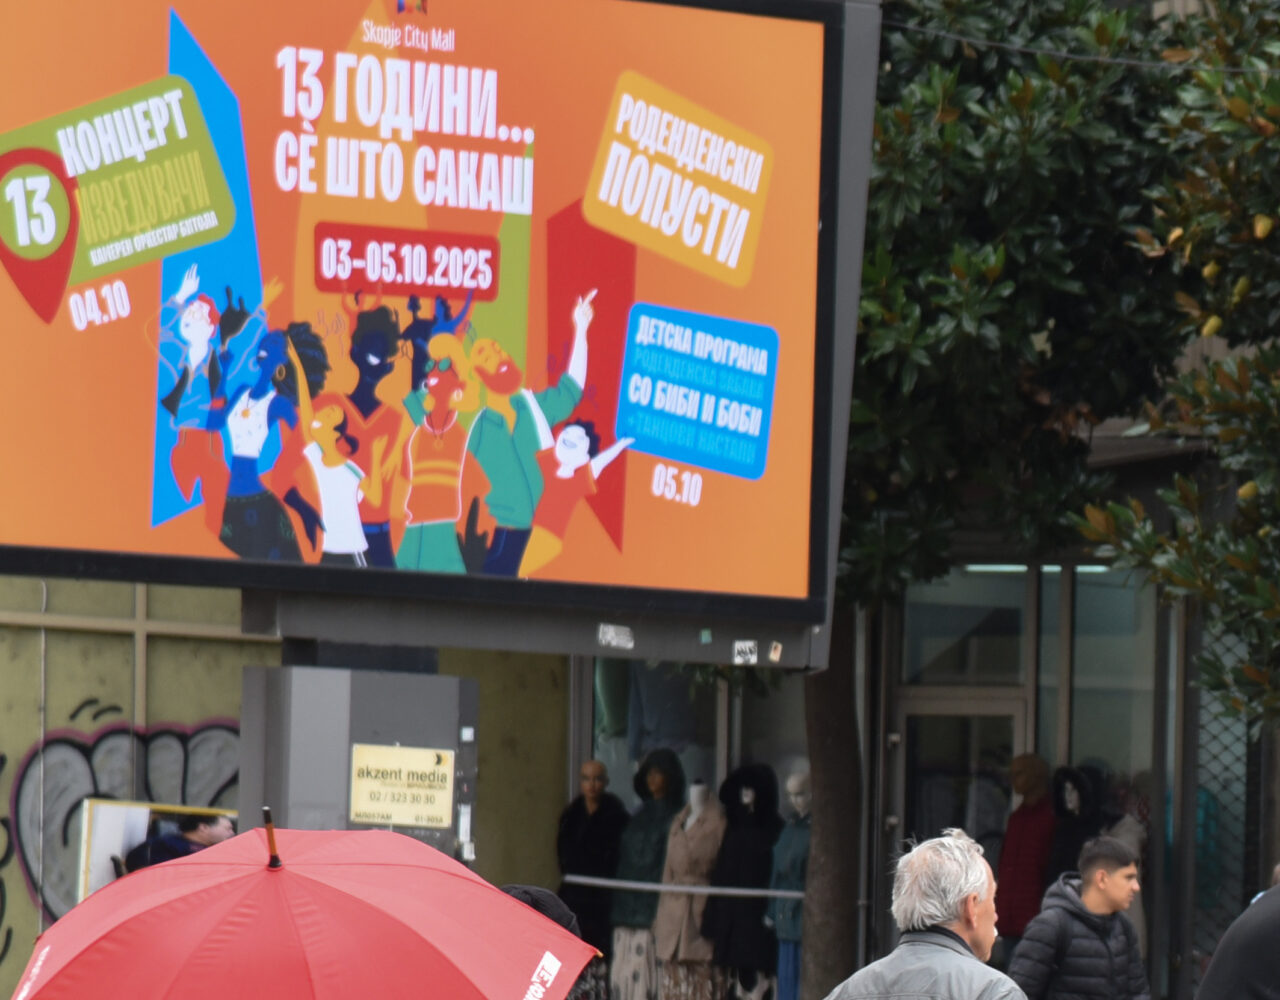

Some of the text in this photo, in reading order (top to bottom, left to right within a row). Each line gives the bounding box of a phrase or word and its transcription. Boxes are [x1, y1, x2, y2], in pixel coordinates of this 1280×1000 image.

[363, 19, 455, 53] Skopje City Mall
[275, 45, 535, 144] 13 ГОДИНИ...
[57, 88, 188, 178] КОНЦЕРТ
[615, 93, 764, 194] РОДЕНДЕНСКИ
[74, 150, 211, 245] ИЗВЕДУВАЧИ
[326, 136, 404, 202] ШТО
[413, 145, 534, 215] САКАШ
[598, 141, 750, 269] ПОПУСТИ
[5, 175, 56, 246] 13
[69, 280, 131, 331] 04.10
[635, 314, 768, 376] ДЕТСКА ПРОГРАМА
[628, 373, 762, 437] СО БИБИ И БОБИ
[652, 463, 703, 507] 05.10
[357, 765, 447, 784] akzent media
[369, 791, 382, 802] 02
[391, 792, 407, 803] 323
[410, 793, 421, 804] 30
[423, 794, 435, 805] 30
